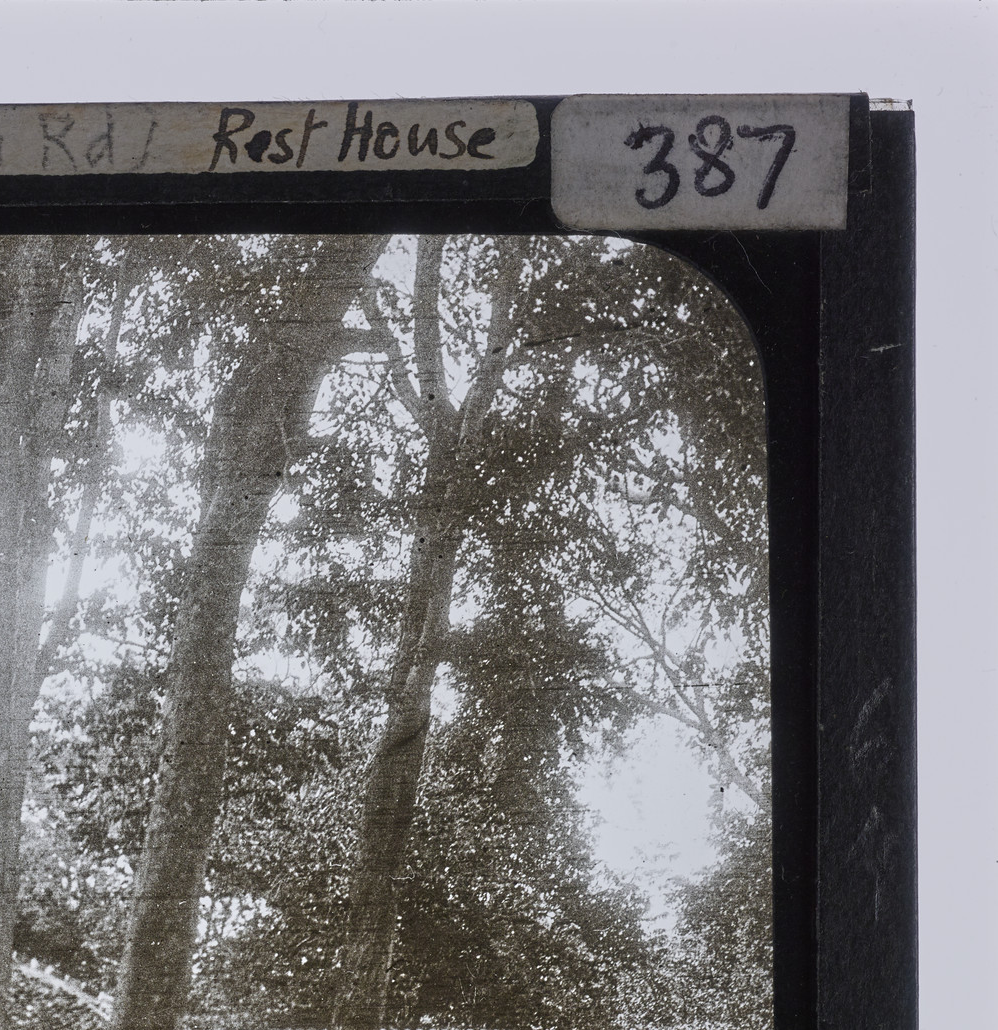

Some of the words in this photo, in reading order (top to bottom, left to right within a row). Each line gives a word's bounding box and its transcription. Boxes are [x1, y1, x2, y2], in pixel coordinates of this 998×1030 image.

[208, 107, 327, 172] Rest
[338, 102, 498, 162] House
[622, 115, 796, 209] 387
